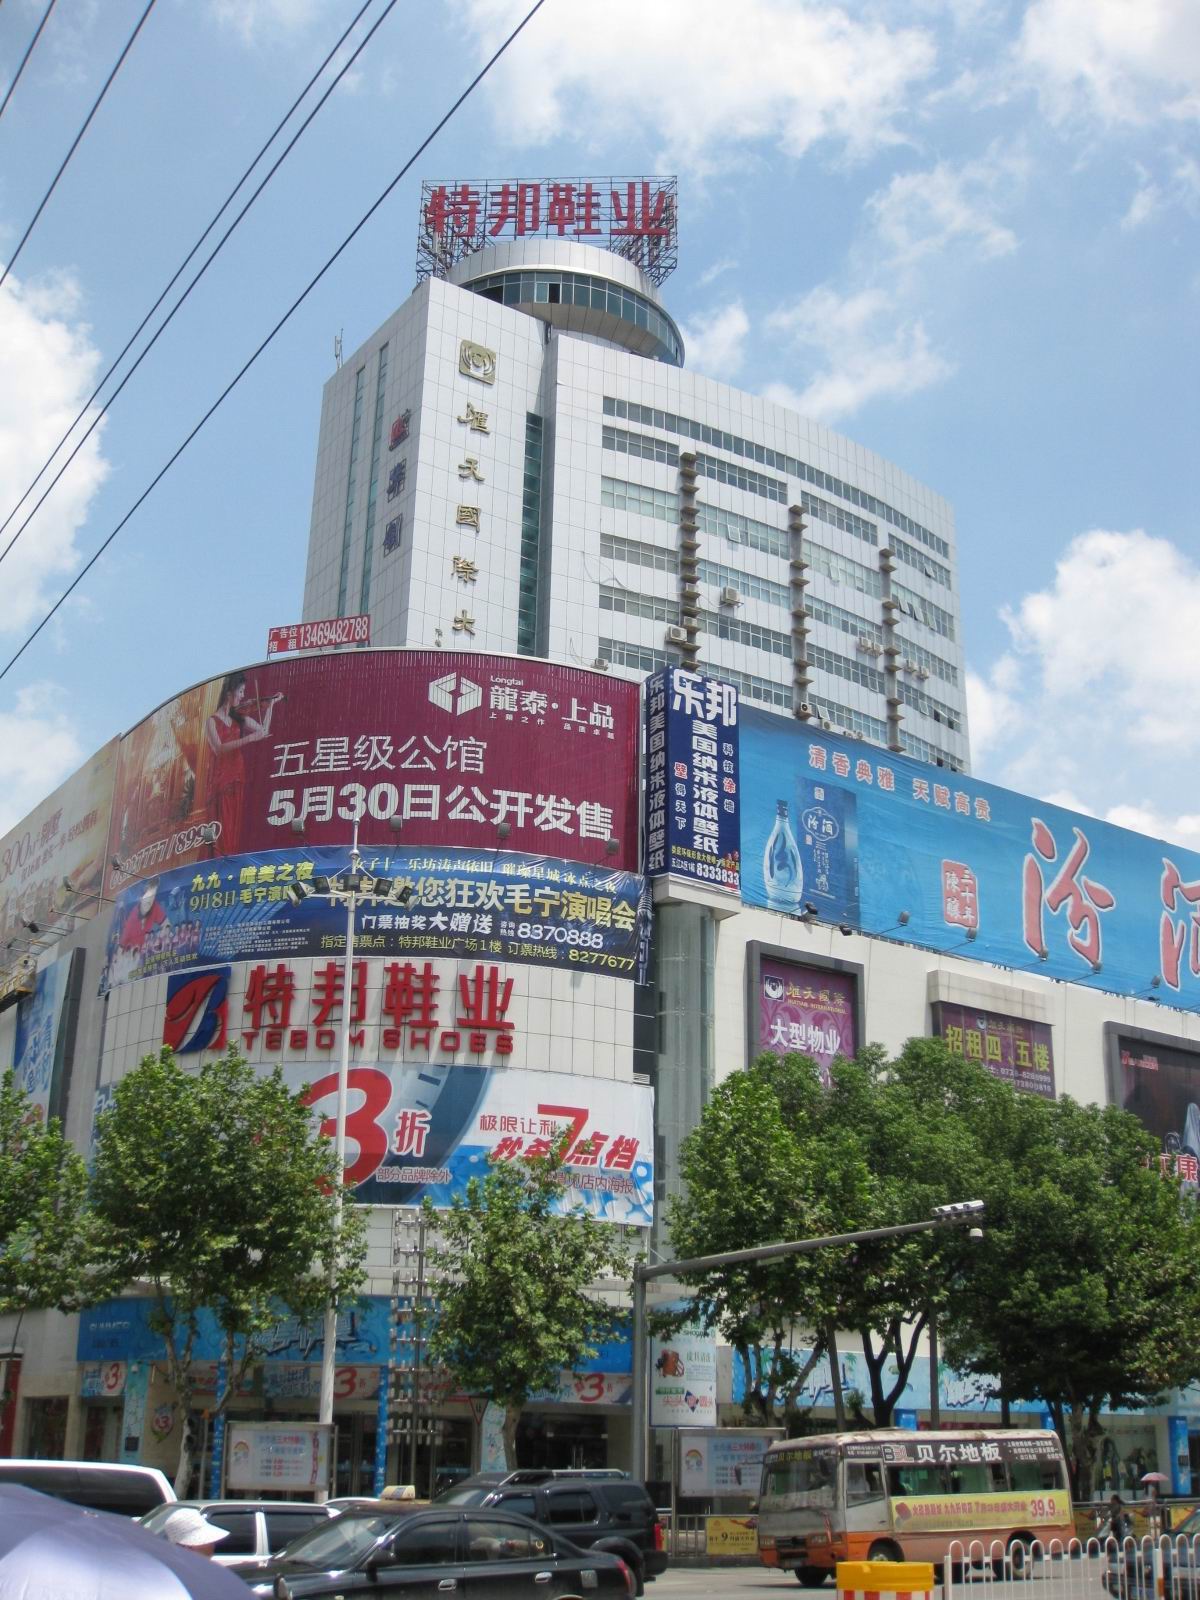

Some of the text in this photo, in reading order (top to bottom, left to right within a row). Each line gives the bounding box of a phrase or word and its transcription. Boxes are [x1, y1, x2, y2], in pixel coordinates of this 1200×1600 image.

[425, 182, 669, 237] 特邦鞋业
[268, 638, 297, 652] 招租
[269, 616, 369, 648] 广告位 13469482788
[672, 668, 737, 727] 乐邦
[270, 735, 487, 778] 五星级公馆
[648, 673, 666, 871] 乐邦美国纳米液体壁纸
[722, 743, 737, 814] 科技涂墙
[674, 762, 688, 830] 壁得天下
[692, 720, 719, 855] 美国纳米液体壁纸
[809, 744, 992, 822] 清香典雅 天赋高贵
[267, 783, 614, 842] 5月30日公开发售
[361, 910, 493, 935] 门票抽奖大赠送
[517, 922, 604, 949] 8370888
[243, 960, 515, 1031] 特邦鞋业
[770, 1018, 841, 1055] 大型物业
[945, 1023, 1050, 1073] 招租四、五楼
[479, 1113, 557, 1137] 极限让利
[375, 1166, 453, 1184] 部分品牌除外
[916, 1442, 1002, 1462] 贝尔地板
[1030, 1498, 1056, 1517] 39.9
